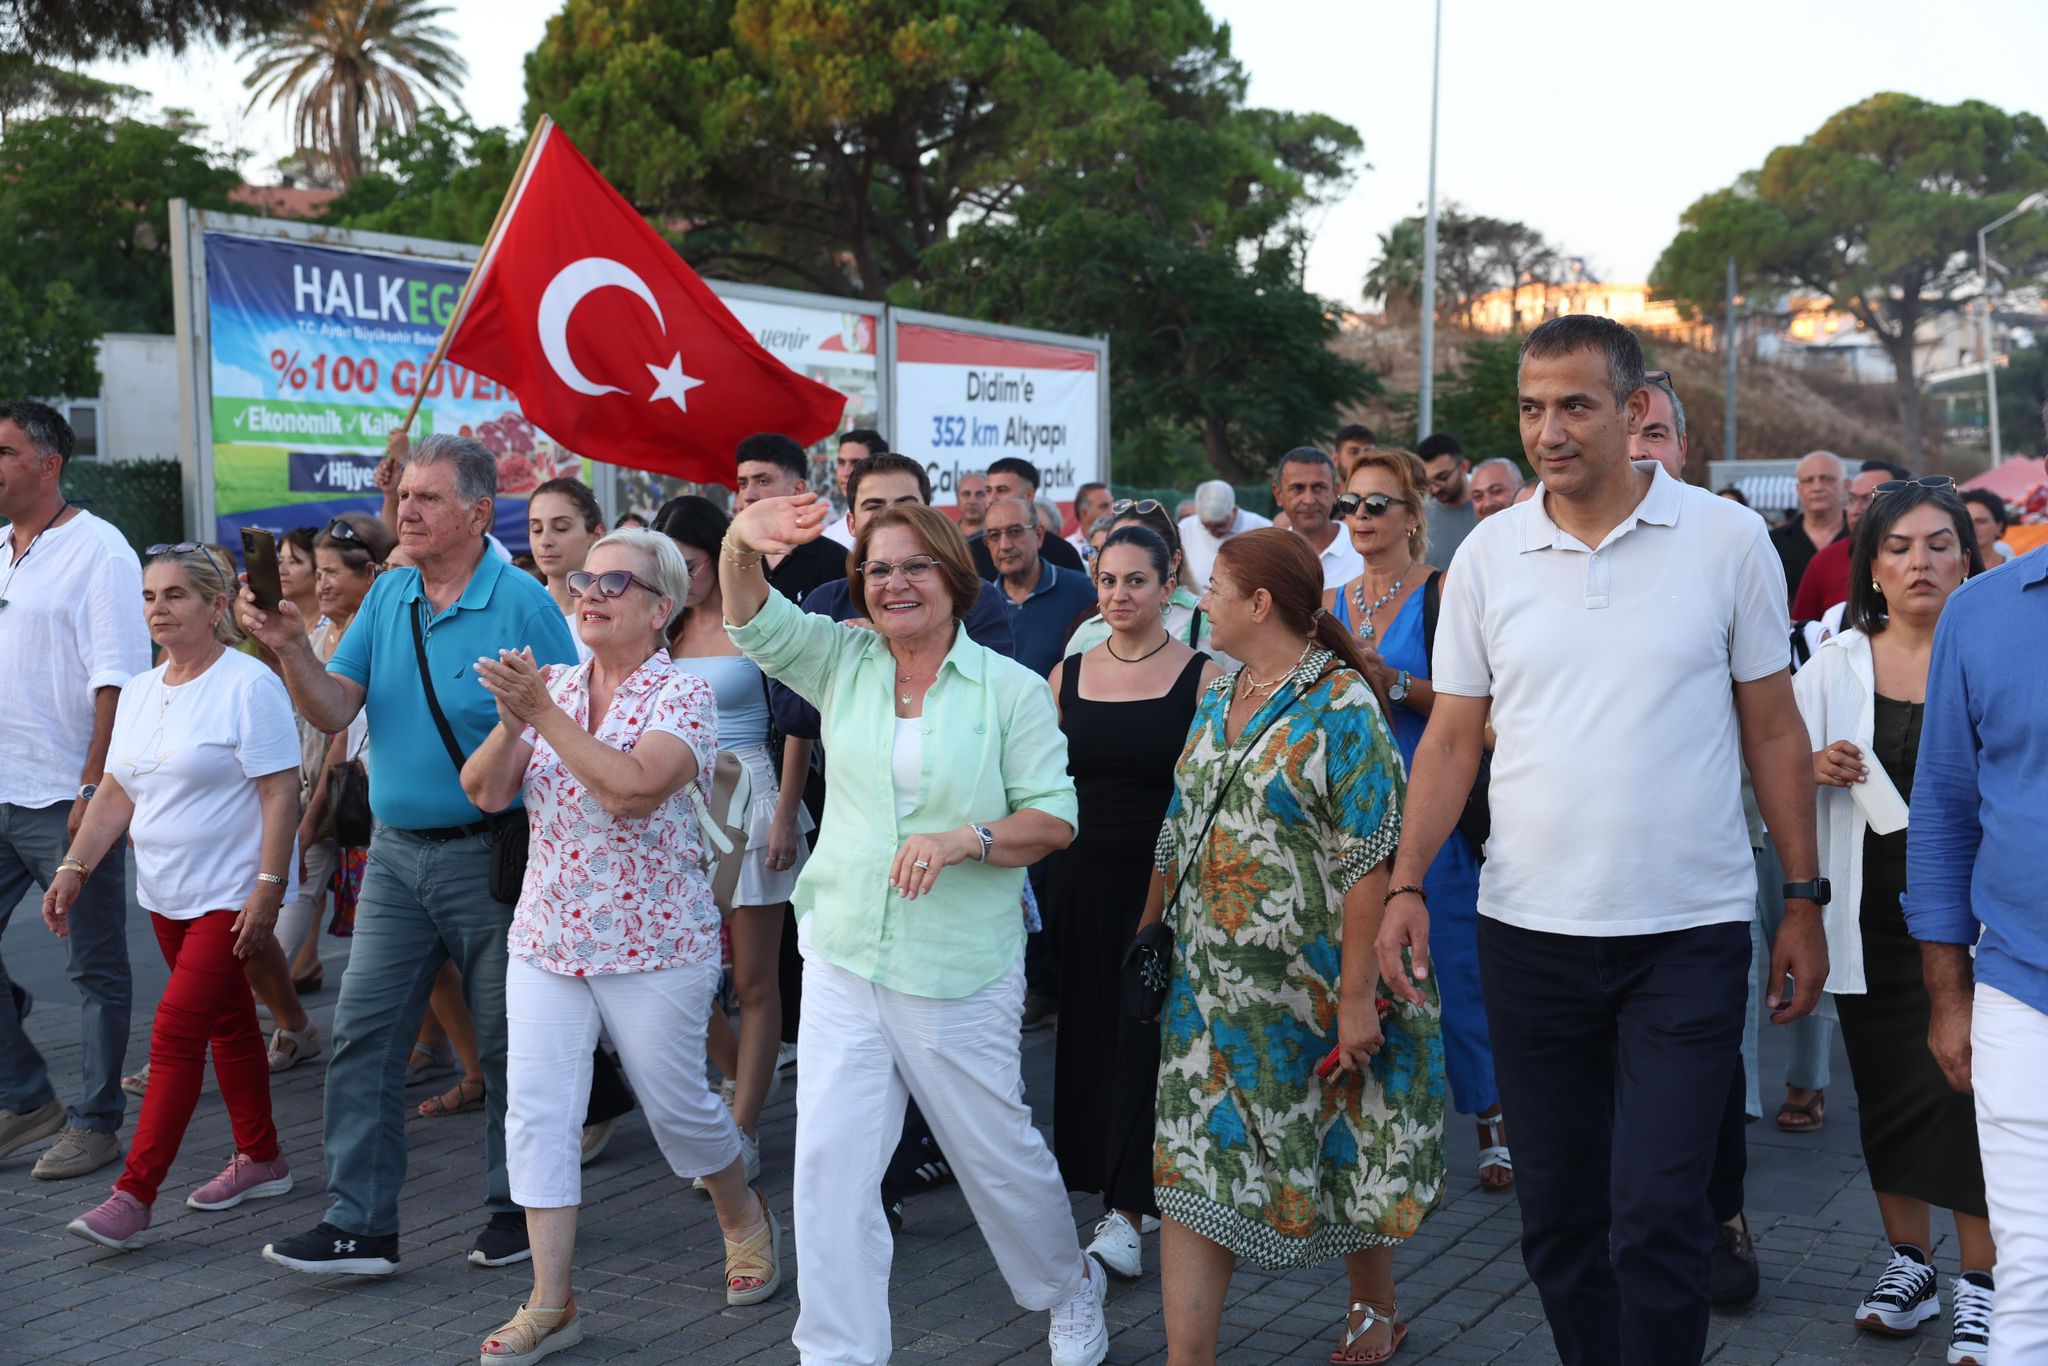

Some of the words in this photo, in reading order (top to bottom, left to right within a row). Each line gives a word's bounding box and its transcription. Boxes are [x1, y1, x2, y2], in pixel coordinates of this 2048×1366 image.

[293, 264, 464, 327] HALKEG
[271, 349, 378, 394] %100
[967, 371, 1034, 403] Didim'e
[249, 405, 343, 436] Ekonomik
[931, 416, 966, 448] 352
[971, 416, 999, 446] km
[1004, 416, 1067, 453] Altyapı
[328, 461, 377, 492] Hijye
